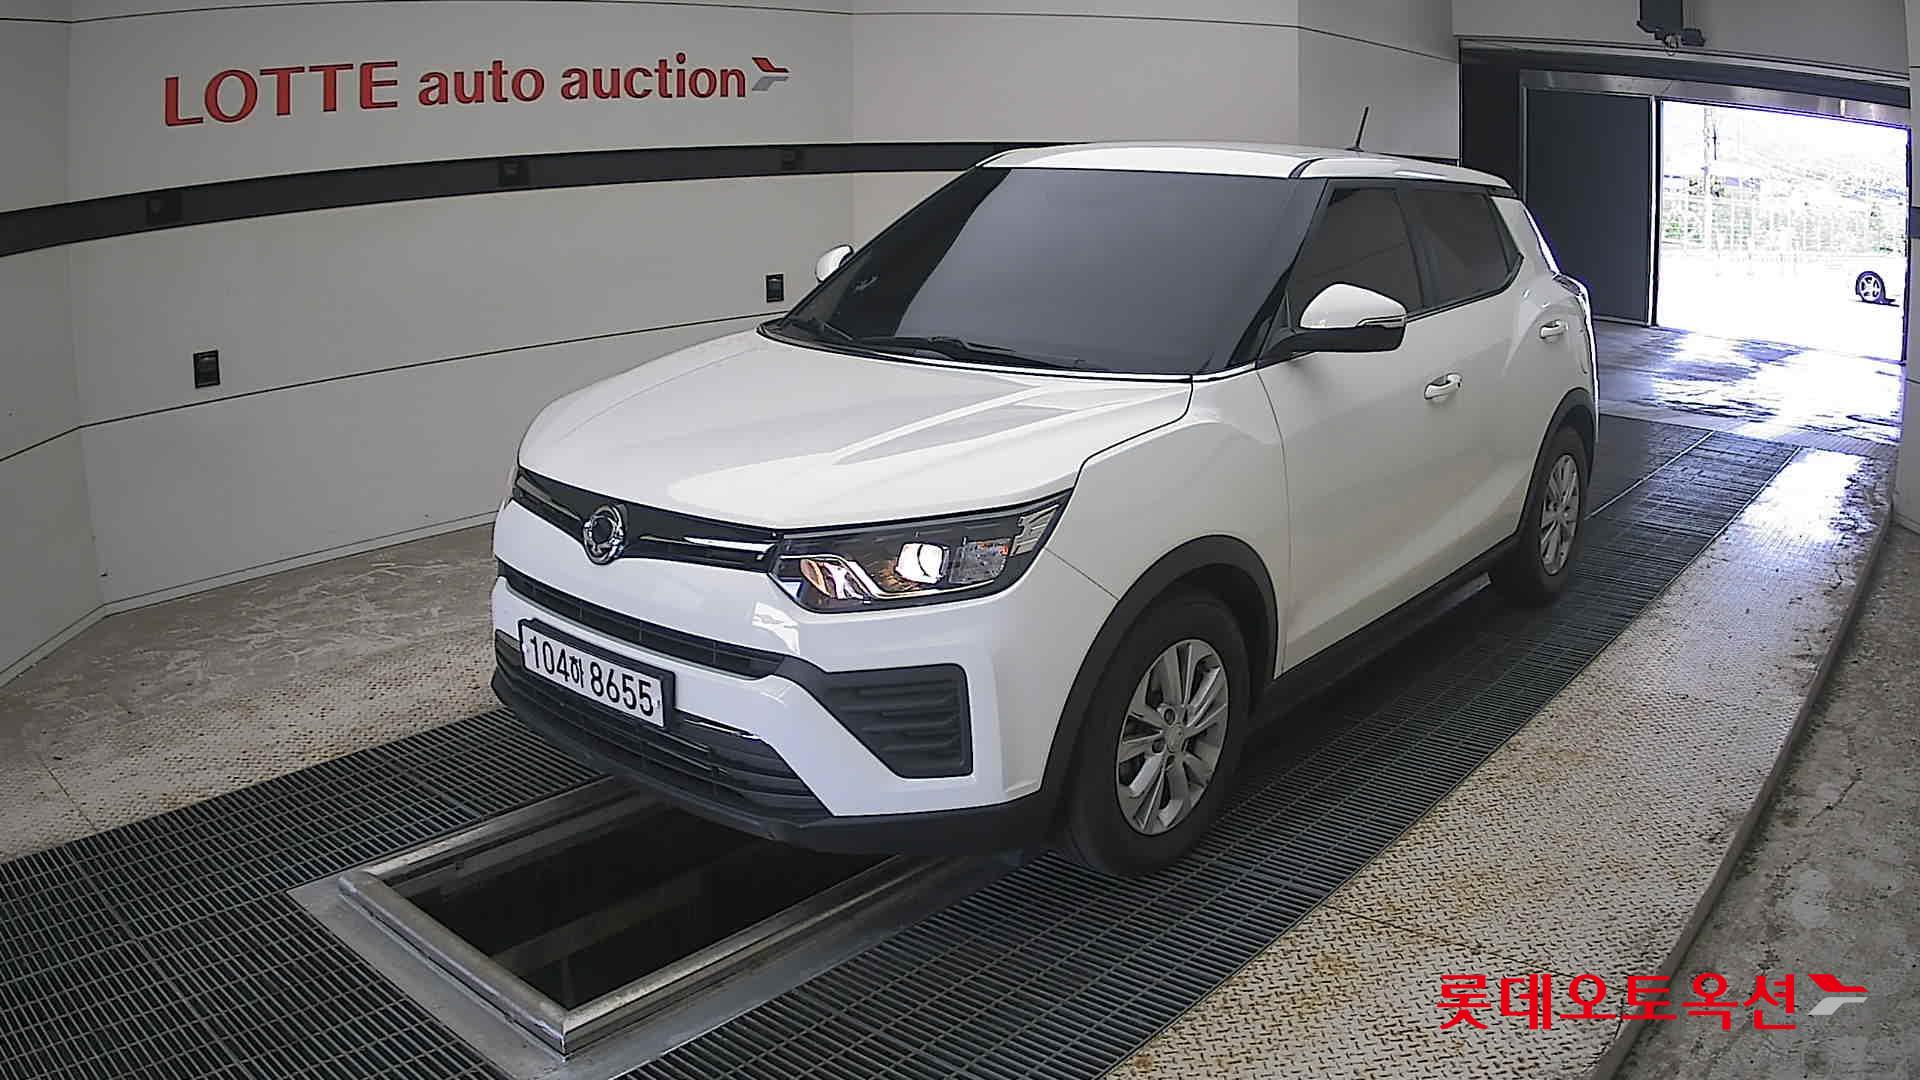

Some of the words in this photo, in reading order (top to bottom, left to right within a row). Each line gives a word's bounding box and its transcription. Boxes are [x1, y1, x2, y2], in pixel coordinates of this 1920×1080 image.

[164, 60, 399, 128] LOTTE
[417, 59, 546, 107] auto
[560, 52, 748, 100] auction
[529, 635, 585, 689] 104하
[590, 661, 654, 717] 8655
